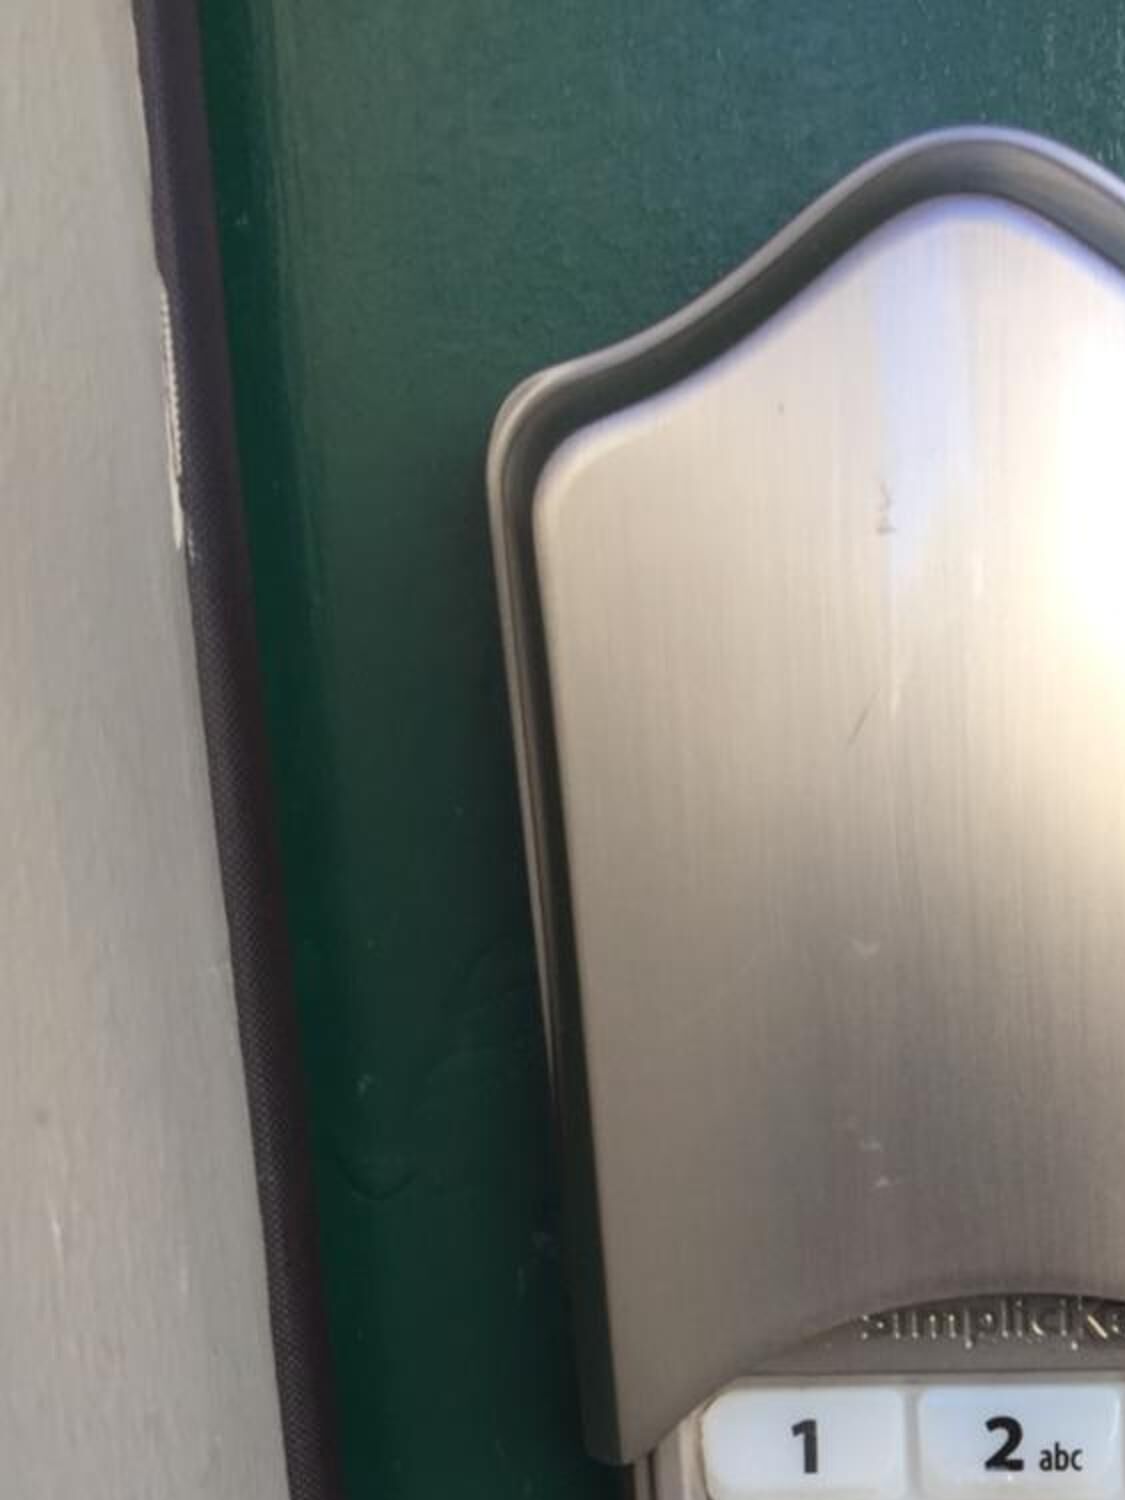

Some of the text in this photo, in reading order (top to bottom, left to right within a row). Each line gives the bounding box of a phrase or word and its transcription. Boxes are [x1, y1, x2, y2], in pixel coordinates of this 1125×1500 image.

[790, 1417, 819, 1475] 1
[983, 1414, 1084, 1473] 2 abc
